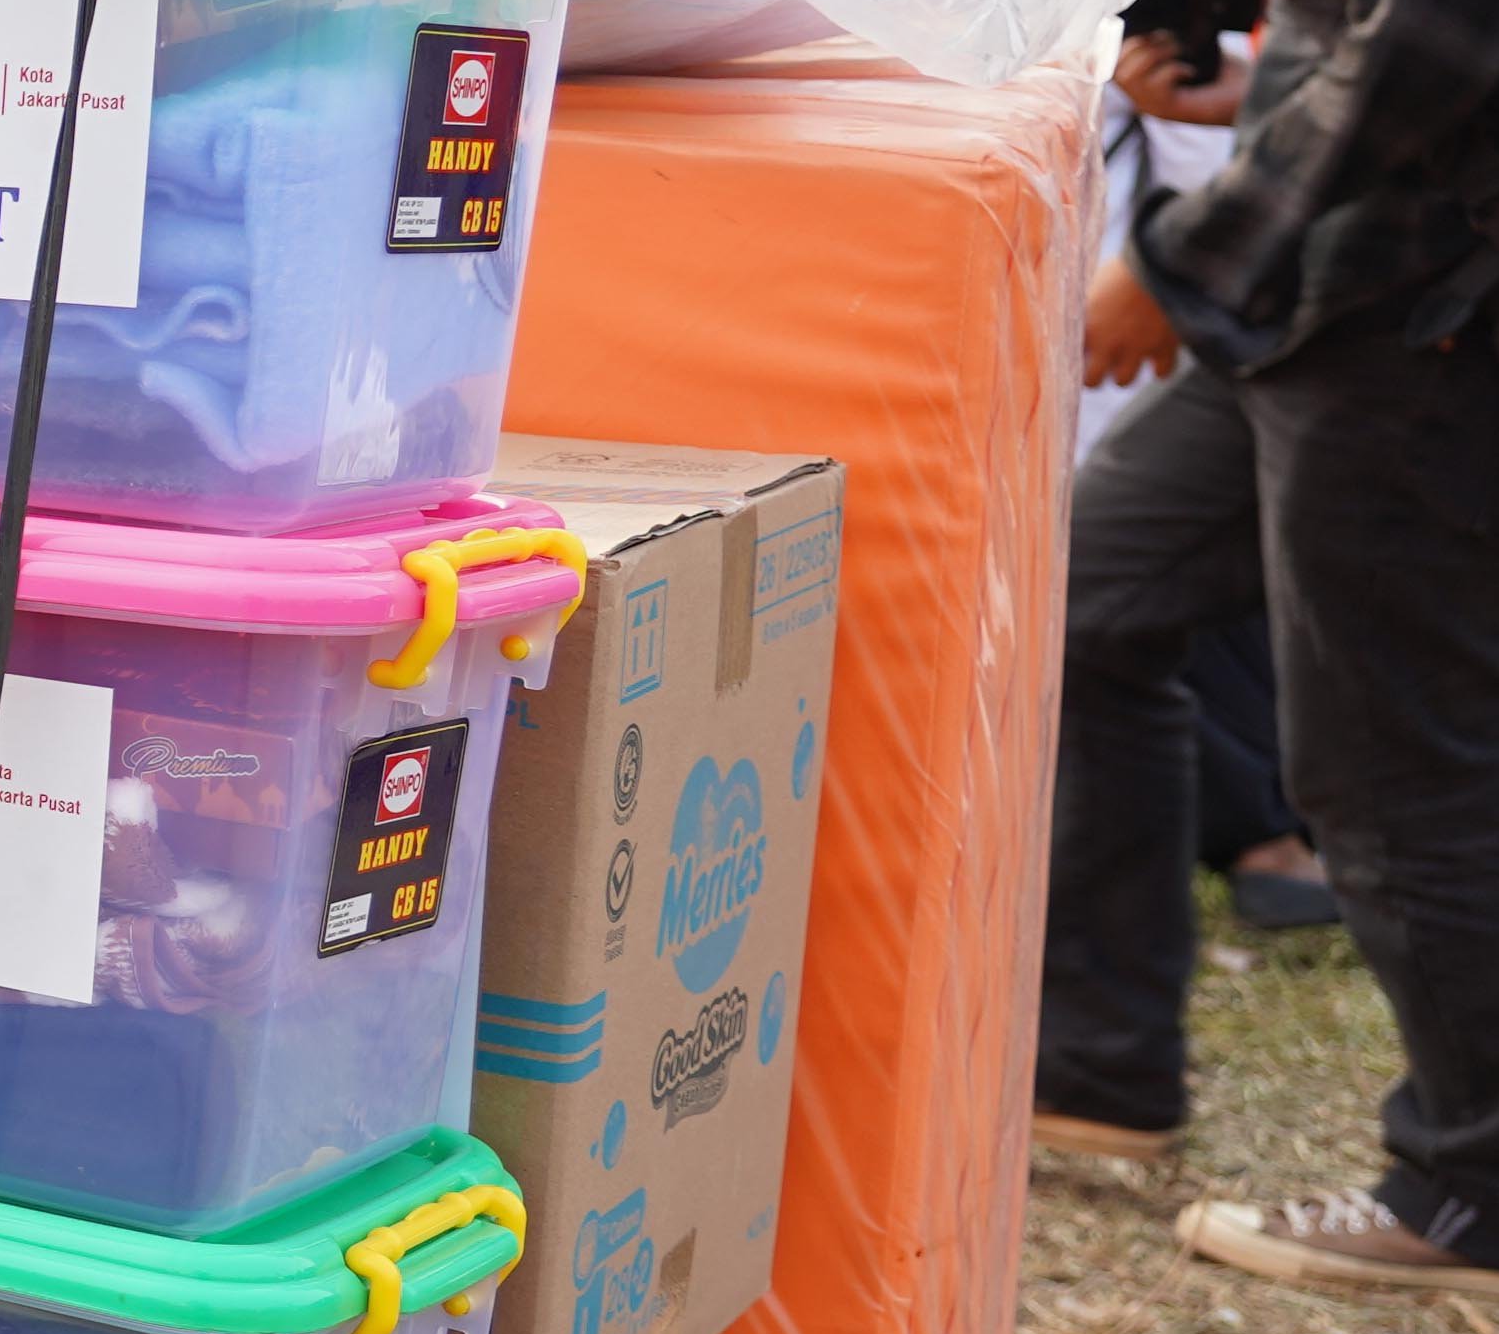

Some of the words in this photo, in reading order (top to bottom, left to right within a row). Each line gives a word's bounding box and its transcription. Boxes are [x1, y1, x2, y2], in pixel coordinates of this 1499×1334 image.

[19, 67, 54, 85] Kota
[452, 77, 487, 100] SHINPO
[18, 91, 73, 111] Jakart
[80, 92, 125, 111] Pusat
[427, 140, 495, 171] HANDY
[461, 200, 482, 233] CB
[485, 200, 502, 232] 15
[385, 773, 420, 799] SHINPO
[39, 794, 81, 815] Pusat
[357, 828, 429, 871] HANDY
[392, 884, 415, 919] CB
[419, 878, 437, 913] 15
[656, 829, 767, 960] Merries
